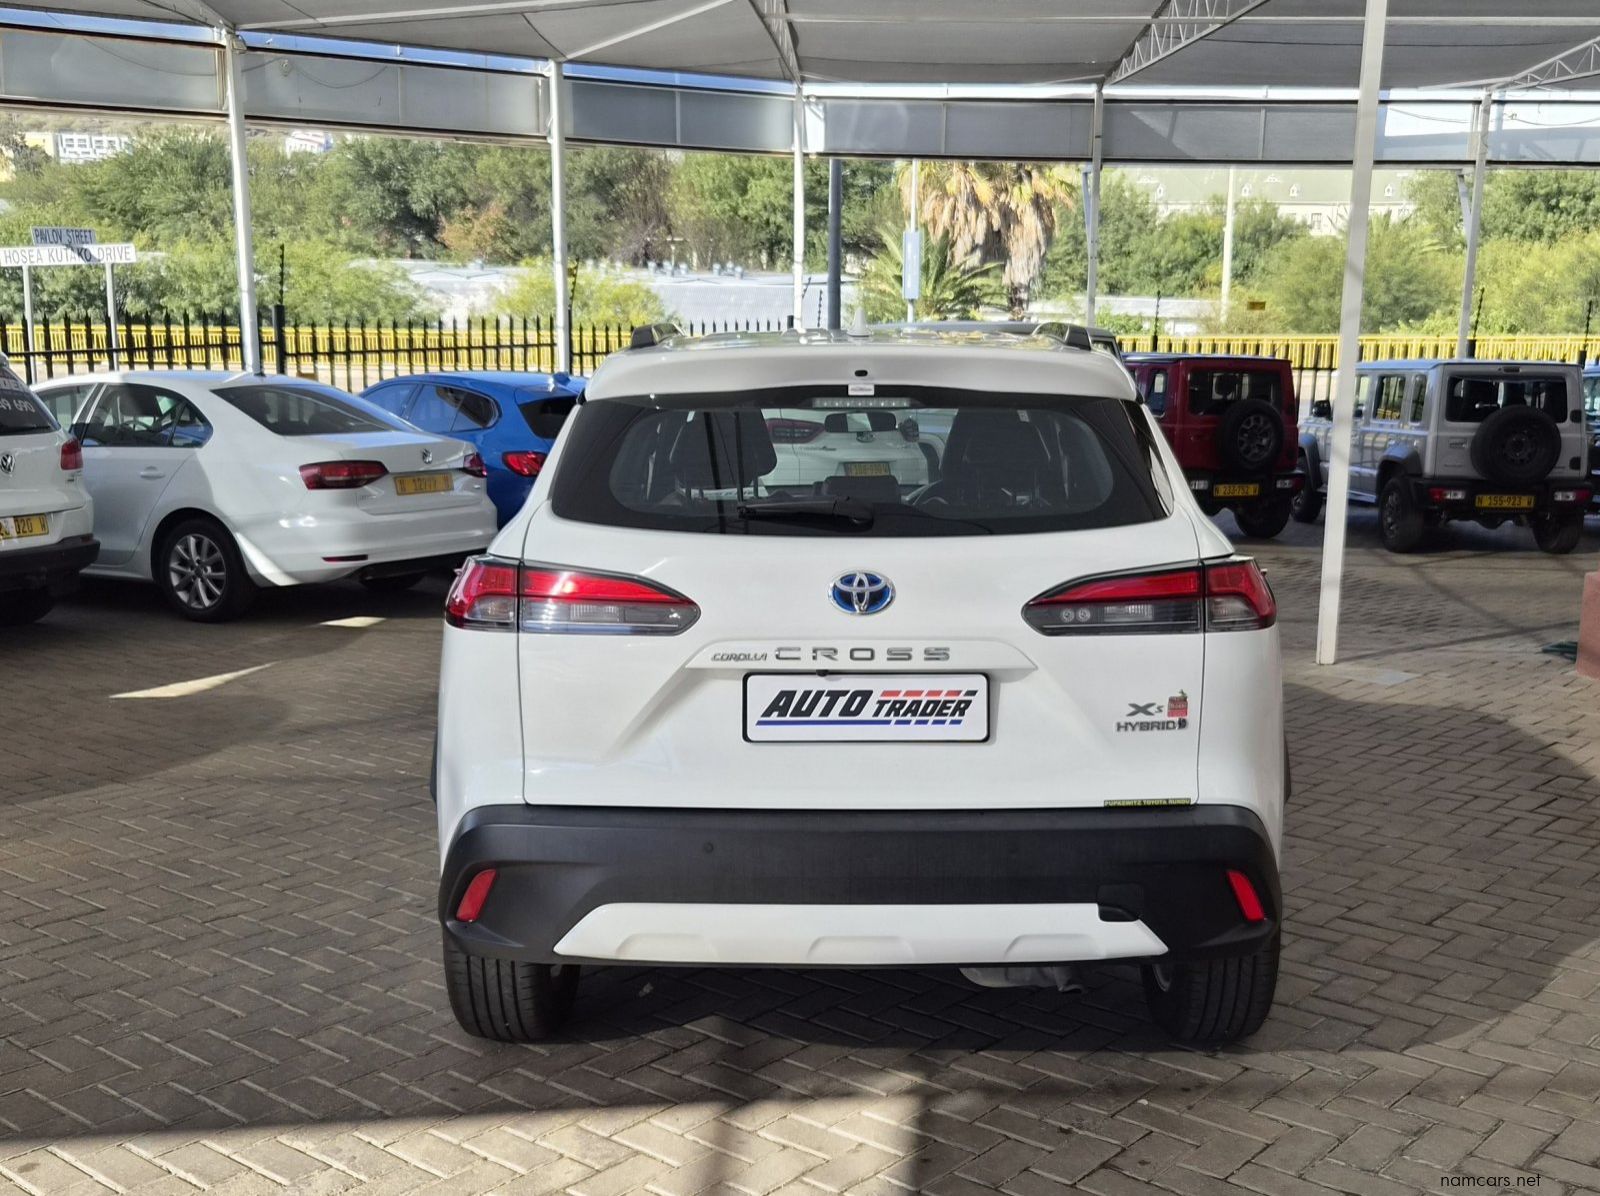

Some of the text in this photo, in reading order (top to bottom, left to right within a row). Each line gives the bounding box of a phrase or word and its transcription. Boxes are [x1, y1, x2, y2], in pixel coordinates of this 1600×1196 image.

[34, 229, 94, 244] PAVLOV STREET
[4, 246, 131, 262] HOSEA KUTAKO DRIVE
[1477, 496, 1484, 506] N
[775, 647, 950, 661] CROSS
[760, 690, 973, 718] AUTO TRADER
[1116, 720, 1177, 732] HYBRID
